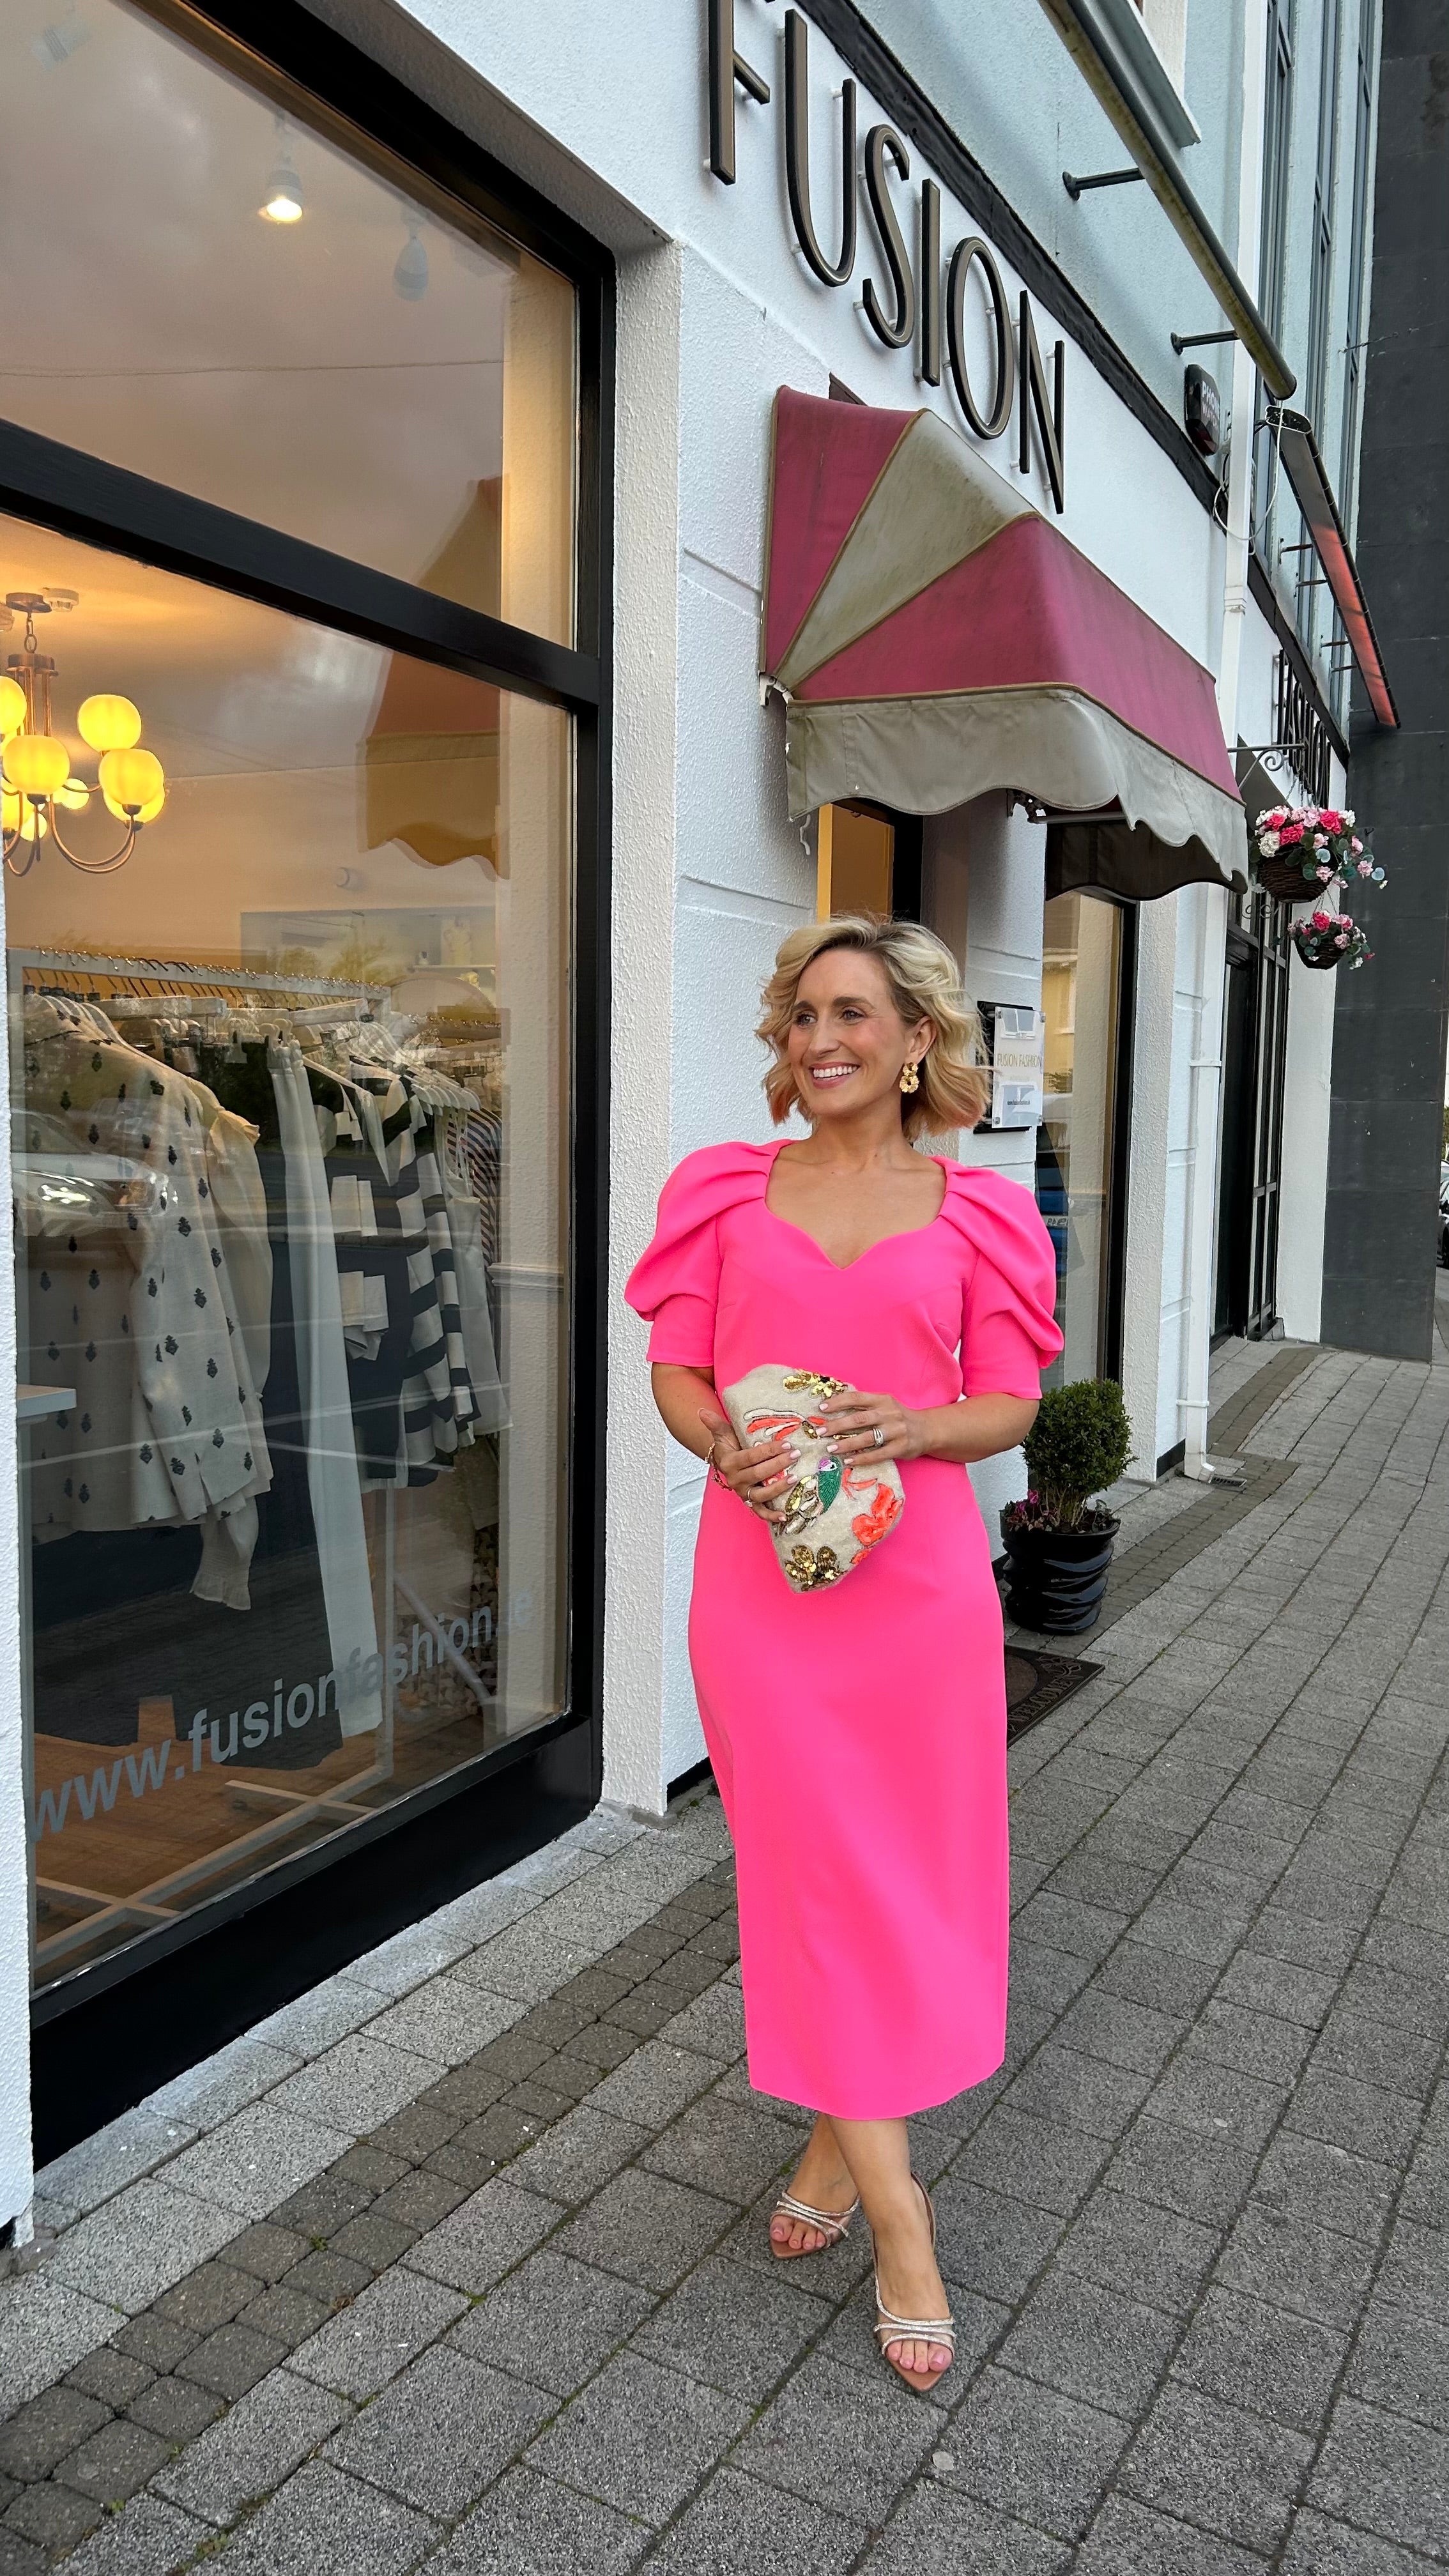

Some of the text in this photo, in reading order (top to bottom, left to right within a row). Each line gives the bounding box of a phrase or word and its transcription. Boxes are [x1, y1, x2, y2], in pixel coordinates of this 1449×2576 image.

[709, 0, 1065, 514] FUSION
[1202, 380, 1220, 420] PHON
[1202, 401, 1218, 427] WATC
[997, 1053, 1043, 1068] FUSION FASHION
